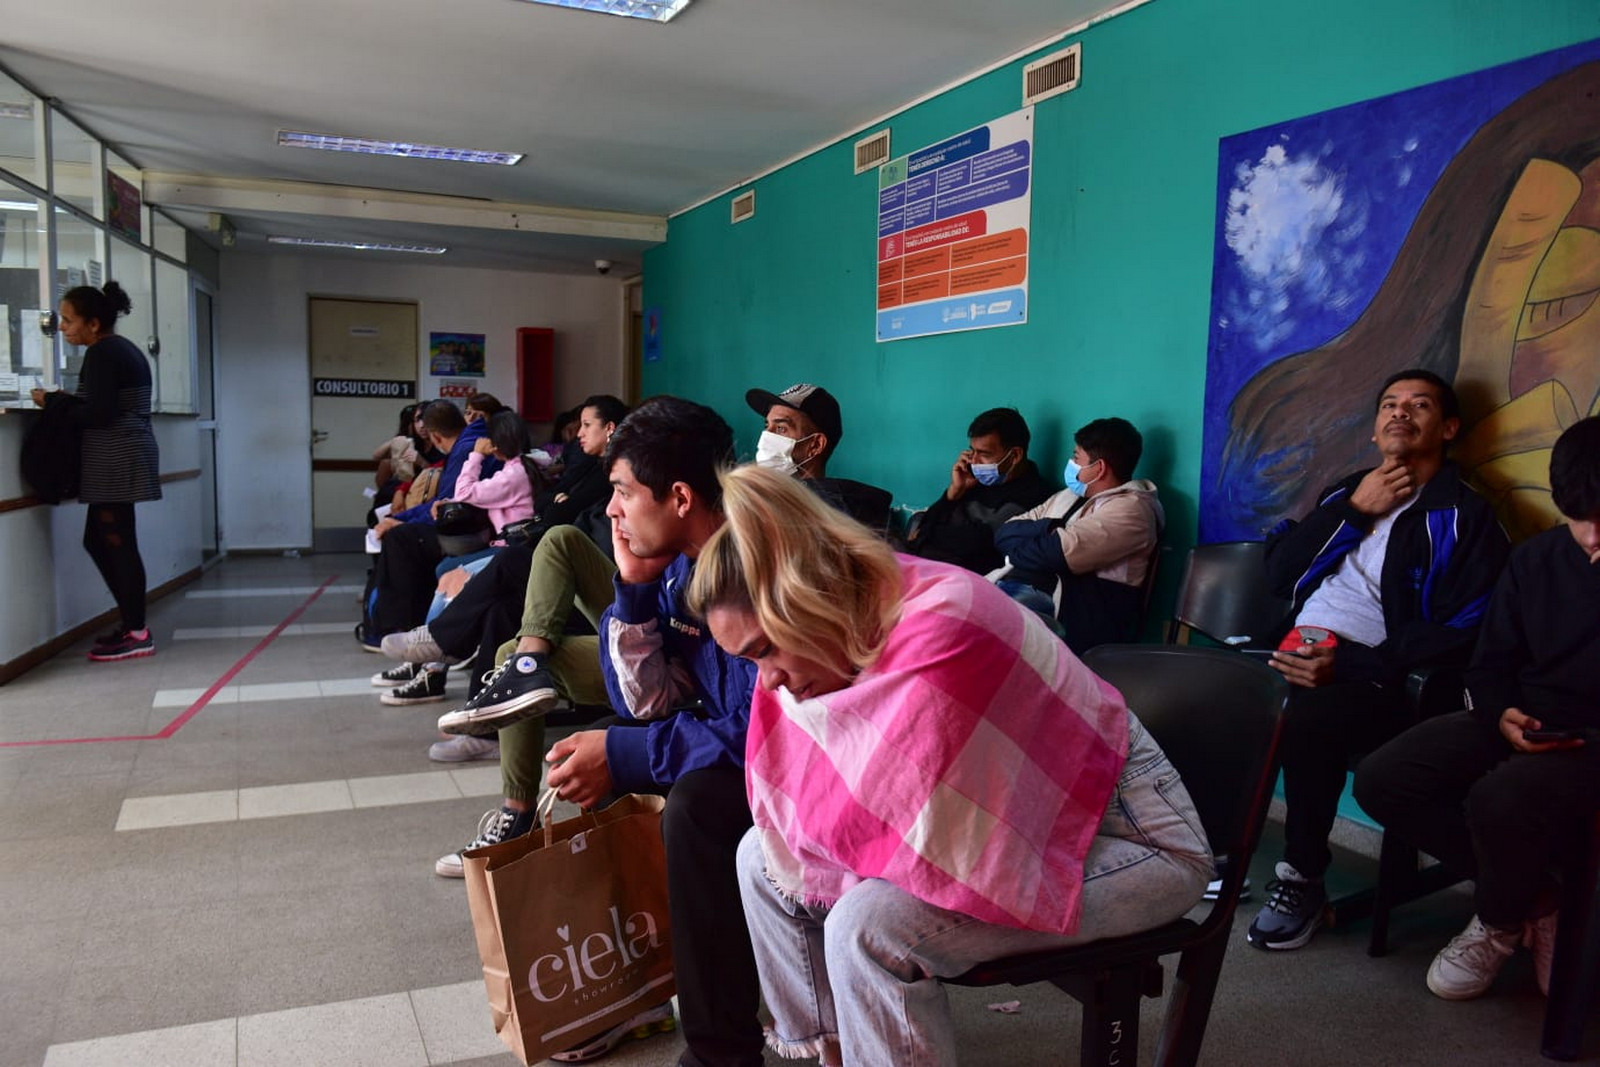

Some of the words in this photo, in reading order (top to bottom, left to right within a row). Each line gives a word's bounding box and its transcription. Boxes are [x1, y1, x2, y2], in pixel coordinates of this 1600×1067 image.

[316, 380, 400, 394] CONSULTORIO
[402, 383, 409, 396] 1
[528, 905, 664, 1002] ciela
